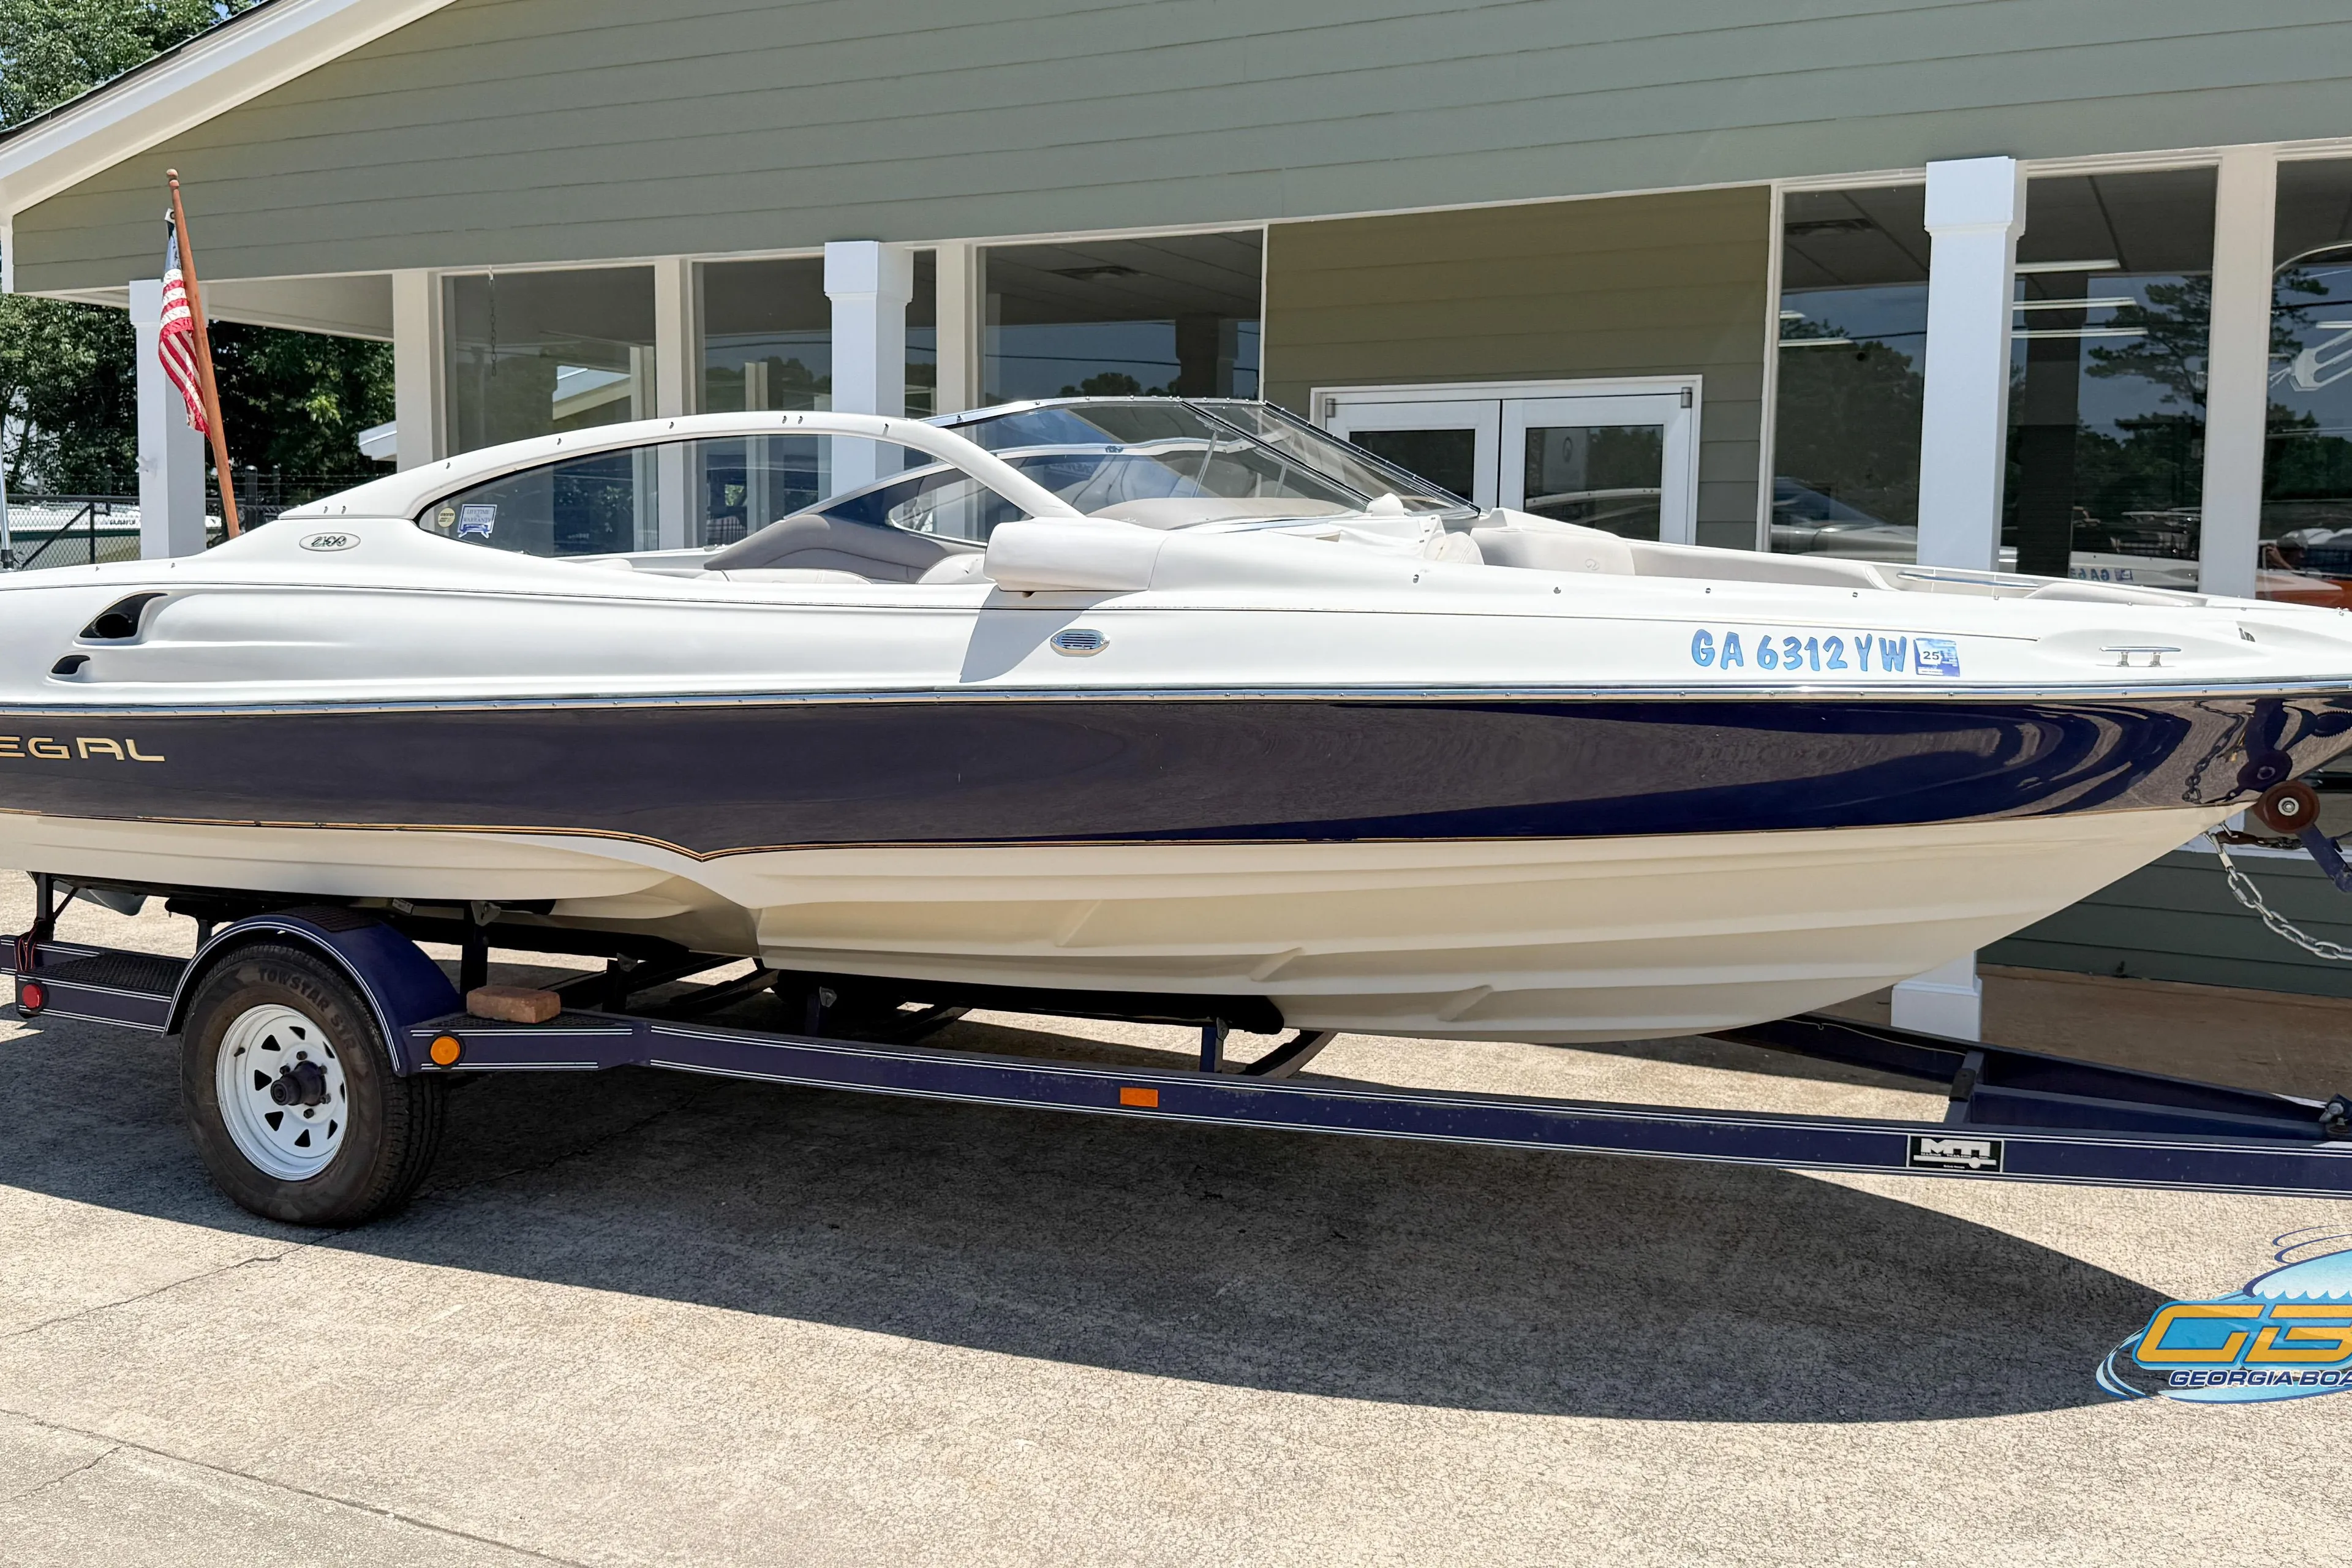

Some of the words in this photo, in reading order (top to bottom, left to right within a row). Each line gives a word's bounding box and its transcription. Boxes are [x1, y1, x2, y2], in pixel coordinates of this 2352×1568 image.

[311, 535, 347, 547] 2100
[1691, 628, 1744, 669] GA
[1923, 650, 1940, 660] 25
